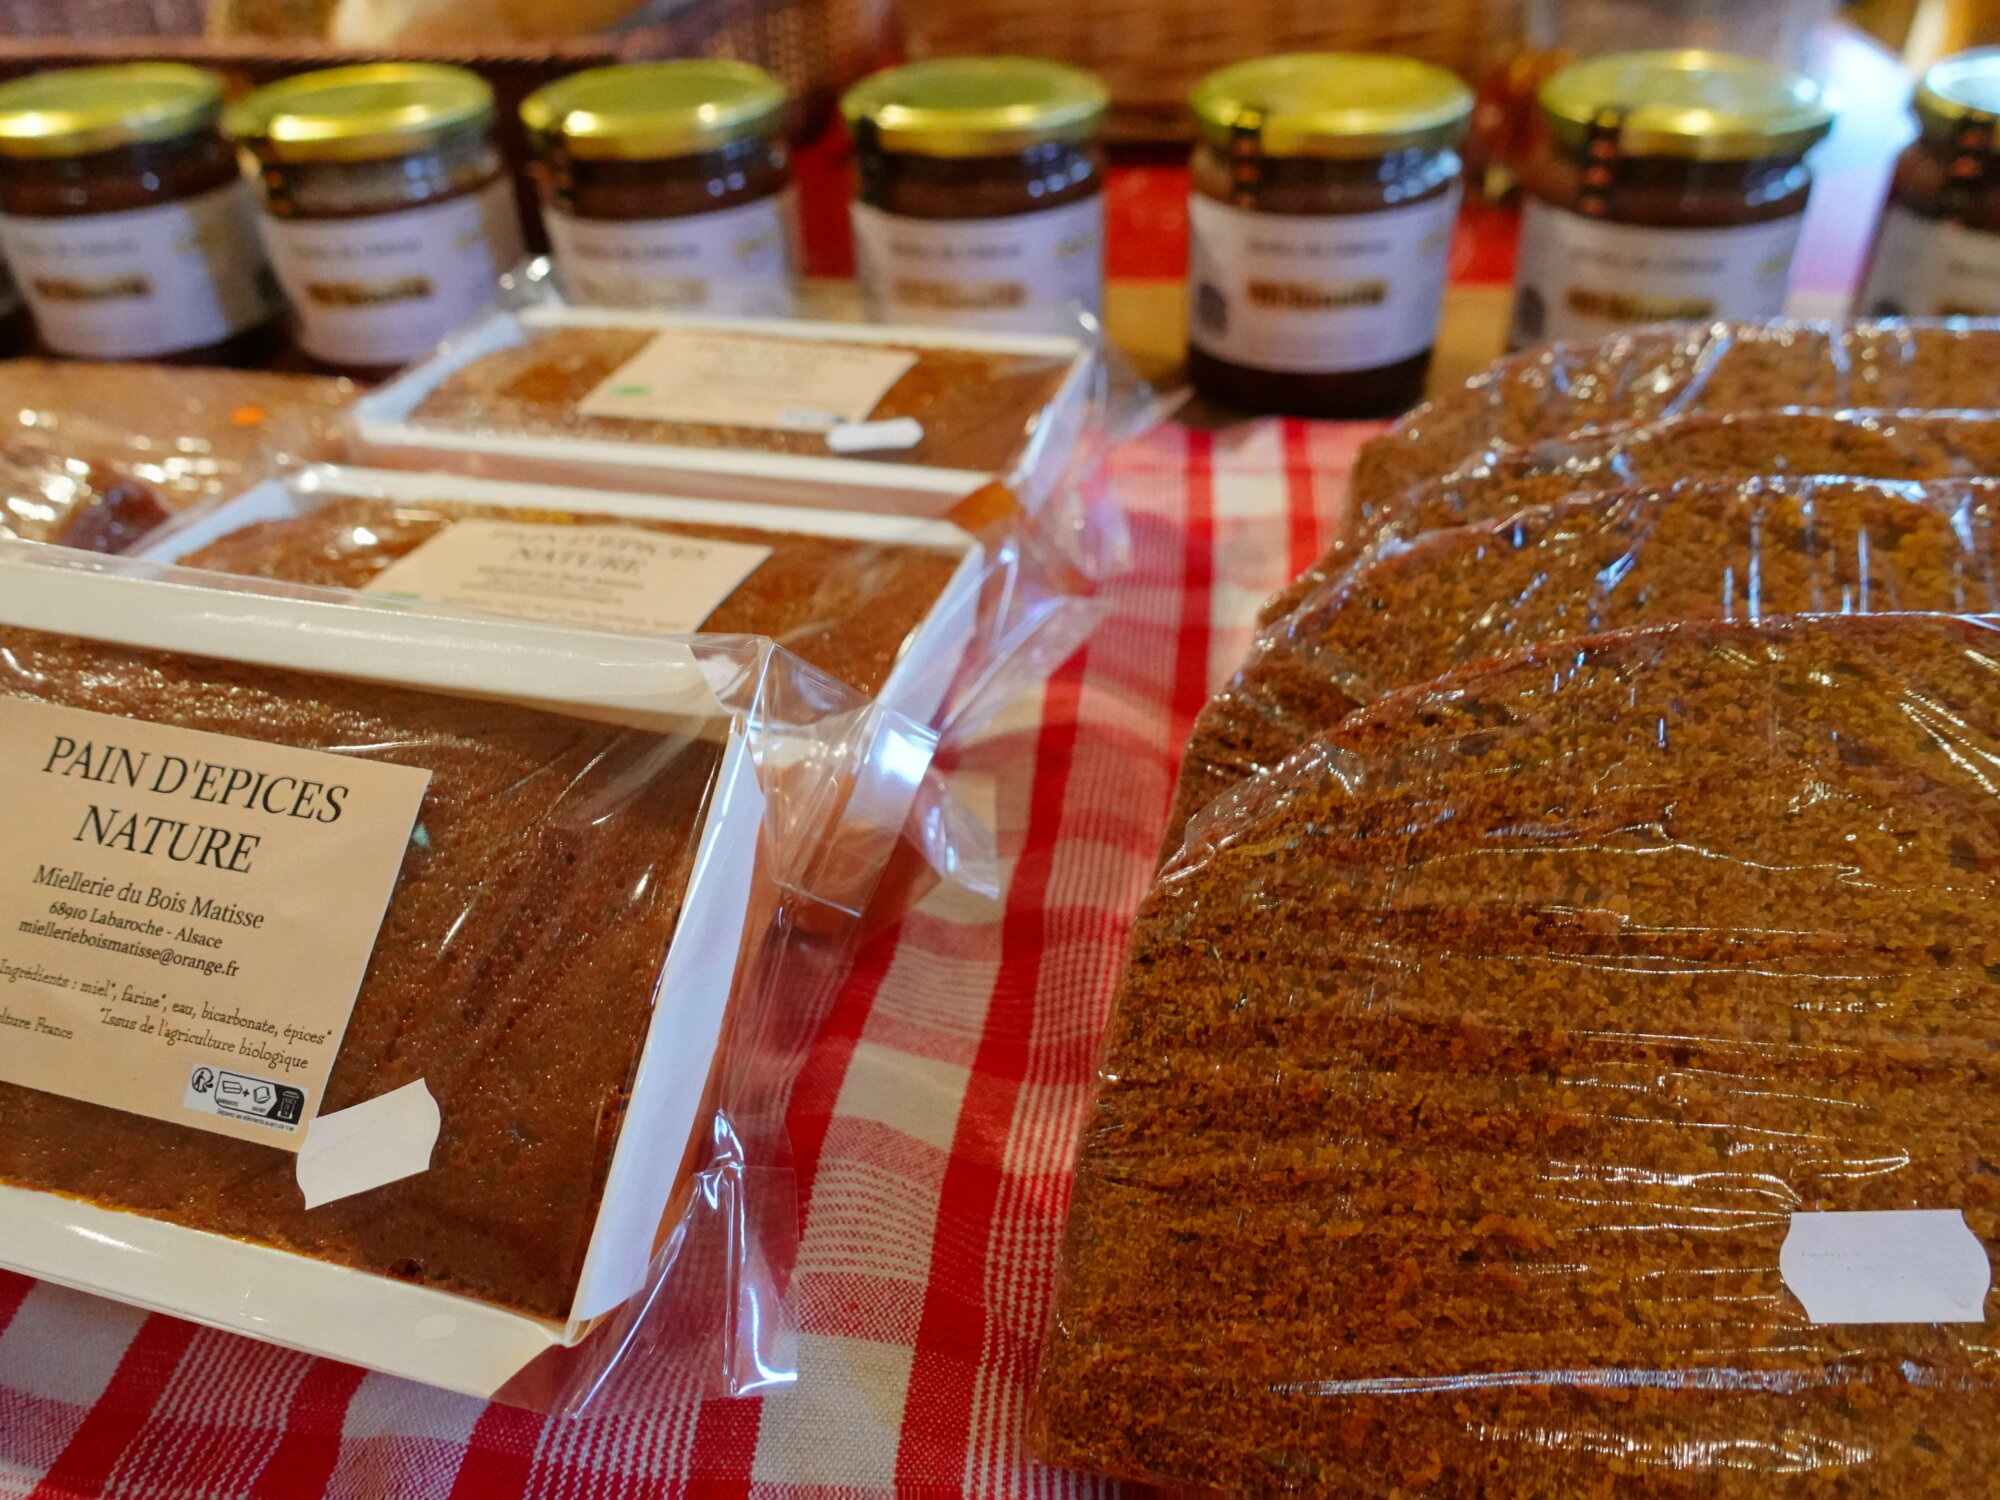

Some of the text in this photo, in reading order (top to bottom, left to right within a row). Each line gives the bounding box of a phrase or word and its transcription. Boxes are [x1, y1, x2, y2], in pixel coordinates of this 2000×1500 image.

[42, 736, 349, 823] PAIN D'EPICES
[73, 805, 261, 873] NATURE
[32, 864, 265, 929] Miellerie du Bois Matisse
[49, 901, 88, 920] 68910
[90, 908, 164, 937] Labaroche
[174, 926, 223, 949] Alsace
[18, 919, 240, 977] miellerieboismatisse@orange.fr
[0, 1007, 74, 1040] lture France
[139, 1015, 156, 1034] de
[158, 1018, 236, 1053] l'agriculture
[239, 1037, 309, 1072] biologique
[172, 1002, 197, 1020] eau,
[201, 1001, 279, 1037] bicarbonate,
